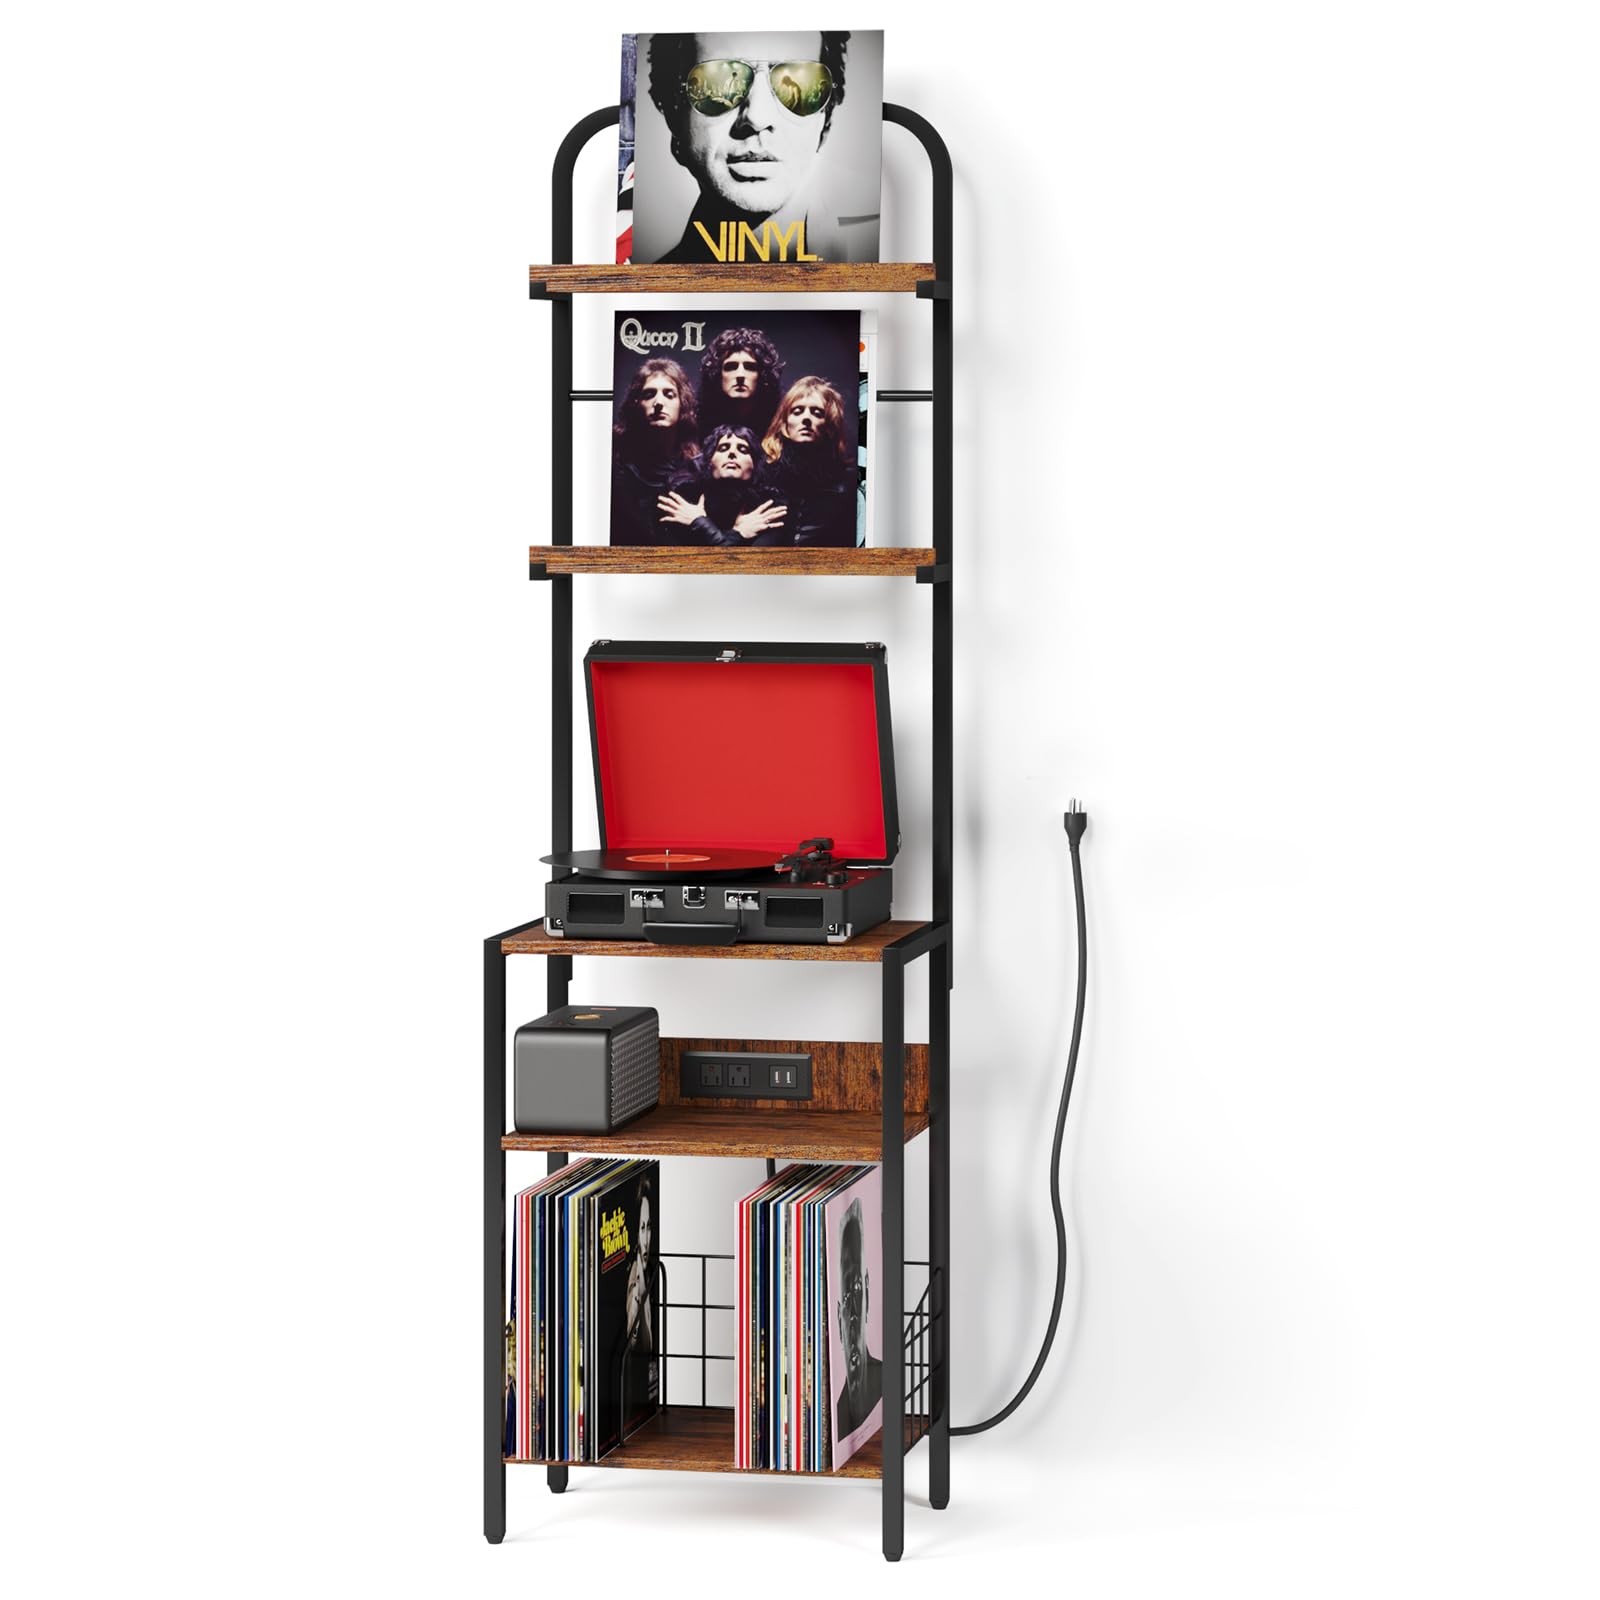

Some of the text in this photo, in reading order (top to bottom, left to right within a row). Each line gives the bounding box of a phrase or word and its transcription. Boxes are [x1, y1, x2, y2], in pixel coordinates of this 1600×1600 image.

[620, 317, 706, 355] Queen II
[600, 1206, 626, 1239] Jackie
[602, 1226, 631, 1259] Brown
